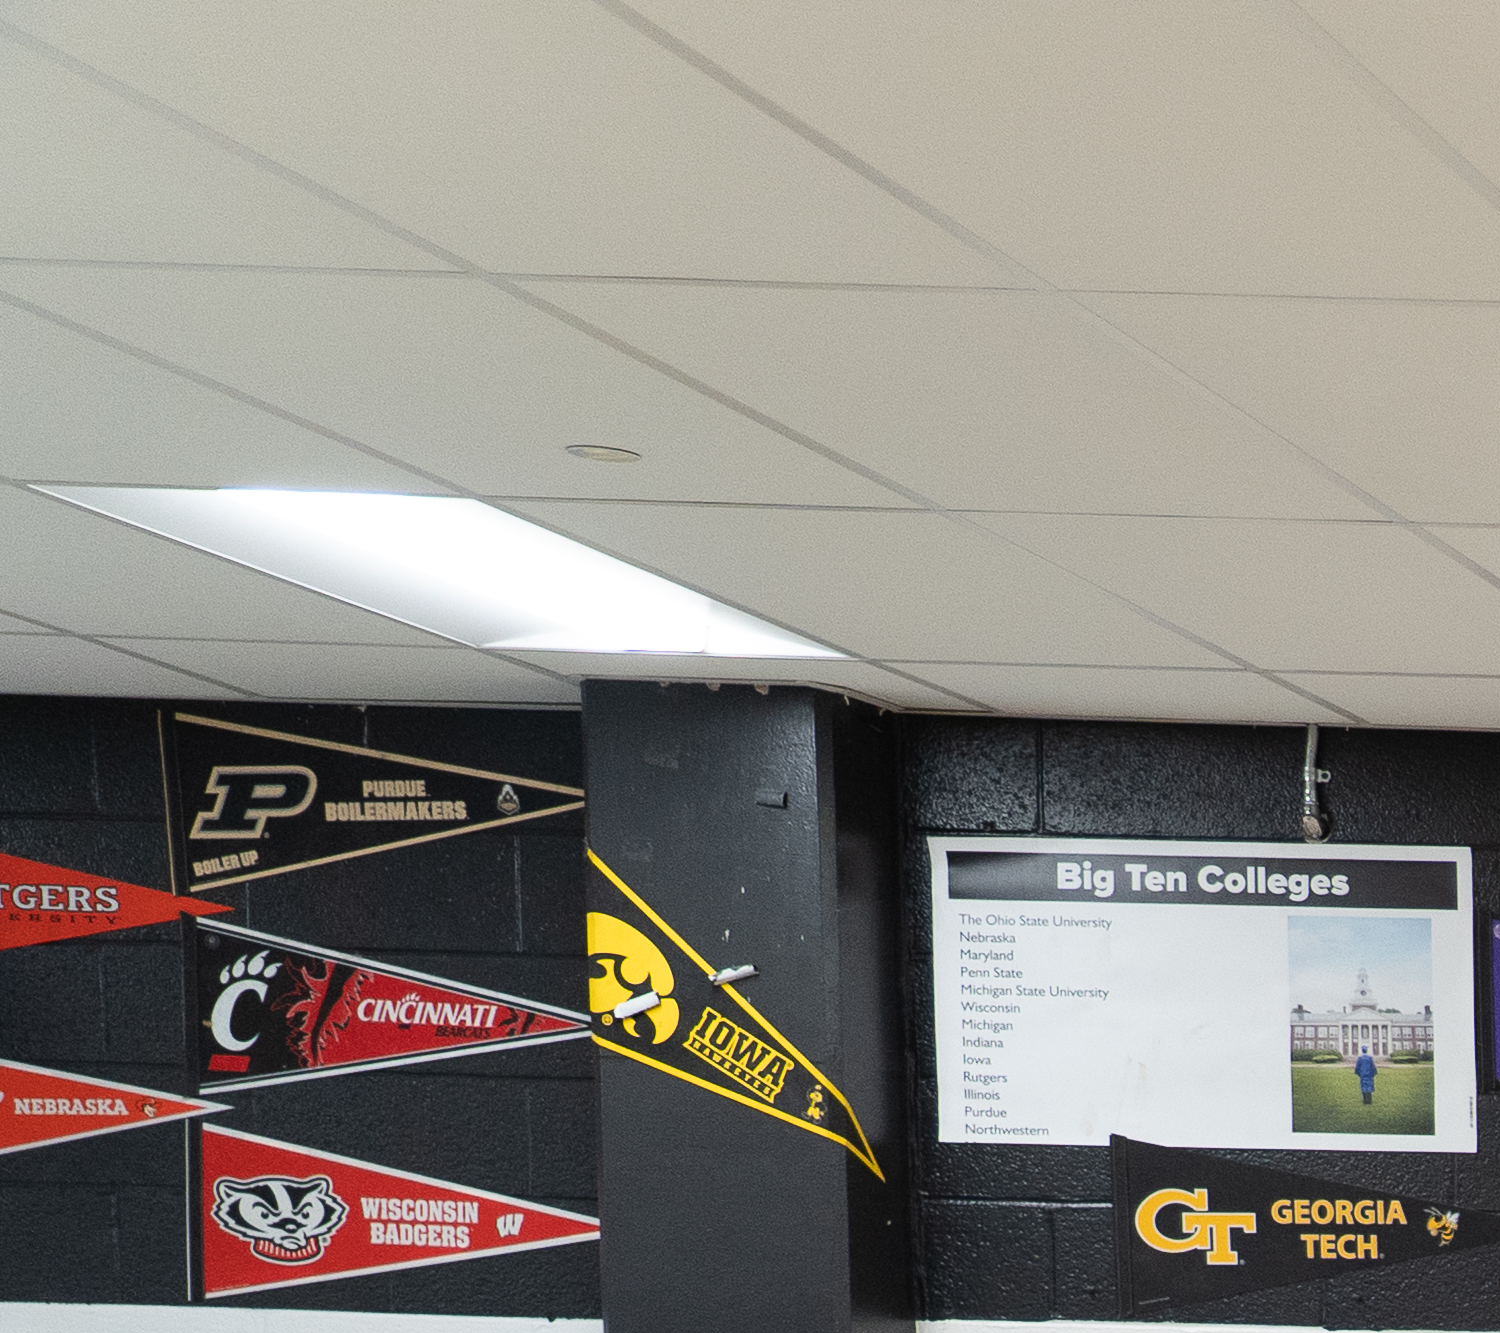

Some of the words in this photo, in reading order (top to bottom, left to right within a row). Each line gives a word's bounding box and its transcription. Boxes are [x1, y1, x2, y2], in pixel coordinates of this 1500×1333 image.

[362, 780, 427, 797] PURDUE
[189, 765, 317, 839] P
[325, 801, 467, 821] BOILERMAKERS
[193, 854, 239, 876] BOILER
[240, 851, 258, 867] UP
[1057, 862, 1115, 897] Big
[1125, 863, 1187, 893] Ten
[1198, 865, 1350, 901] Colleges
[959, 914, 982, 926] The
[986, 914, 1016, 926] Ohio
[1019, 915, 1049, 927] State
[1053, 916, 1112, 931] University
[959, 931, 1016, 943] Nebraska
[960, 949, 1014, 963] Maryland
[961, 967, 990, 978] Penn
[994, 967, 1023, 979] State
[961, 984, 1012, 998] Michigan
[1016, 985, 1046, 997] State
[1049, 986, 1109, 1001] University
[357, 996, 498, 1028] CINCINNATI
[961, 1001, 1021, 1014] Wisconsin
[435, 1025, 492, 1039] BEARCATS
[961, 1019, 1013, 1033] Michigan
[693, 1009, 789, 1087] IOWA
[962, 1037, 1004, 1048] Indiana
[691, 1039, 773, 1097] HAWKEYES
[963, 1054, 991, 1066] Iowa
[963, 1071, 1008, 1085] Rutgers
[964, 1089, 1001, 1101] Illinois
[14, 1098, 129, 1116] NEBRASKA
[965, 1106, 1007, 1118] Purdue
[965, 1124, 1049, 1136] Northwestern
[361, 1197, 479, 1224] WISCONSIN
[1271, 1199, 1407, 1225] GEORGIA
[497, 1214, 523, 1237] W
[1135, 1188, 1257, 1265] GT
[371, 1223, 470, 1248] BADGERS
[1300, 1233, 1379, 1260] TECH
